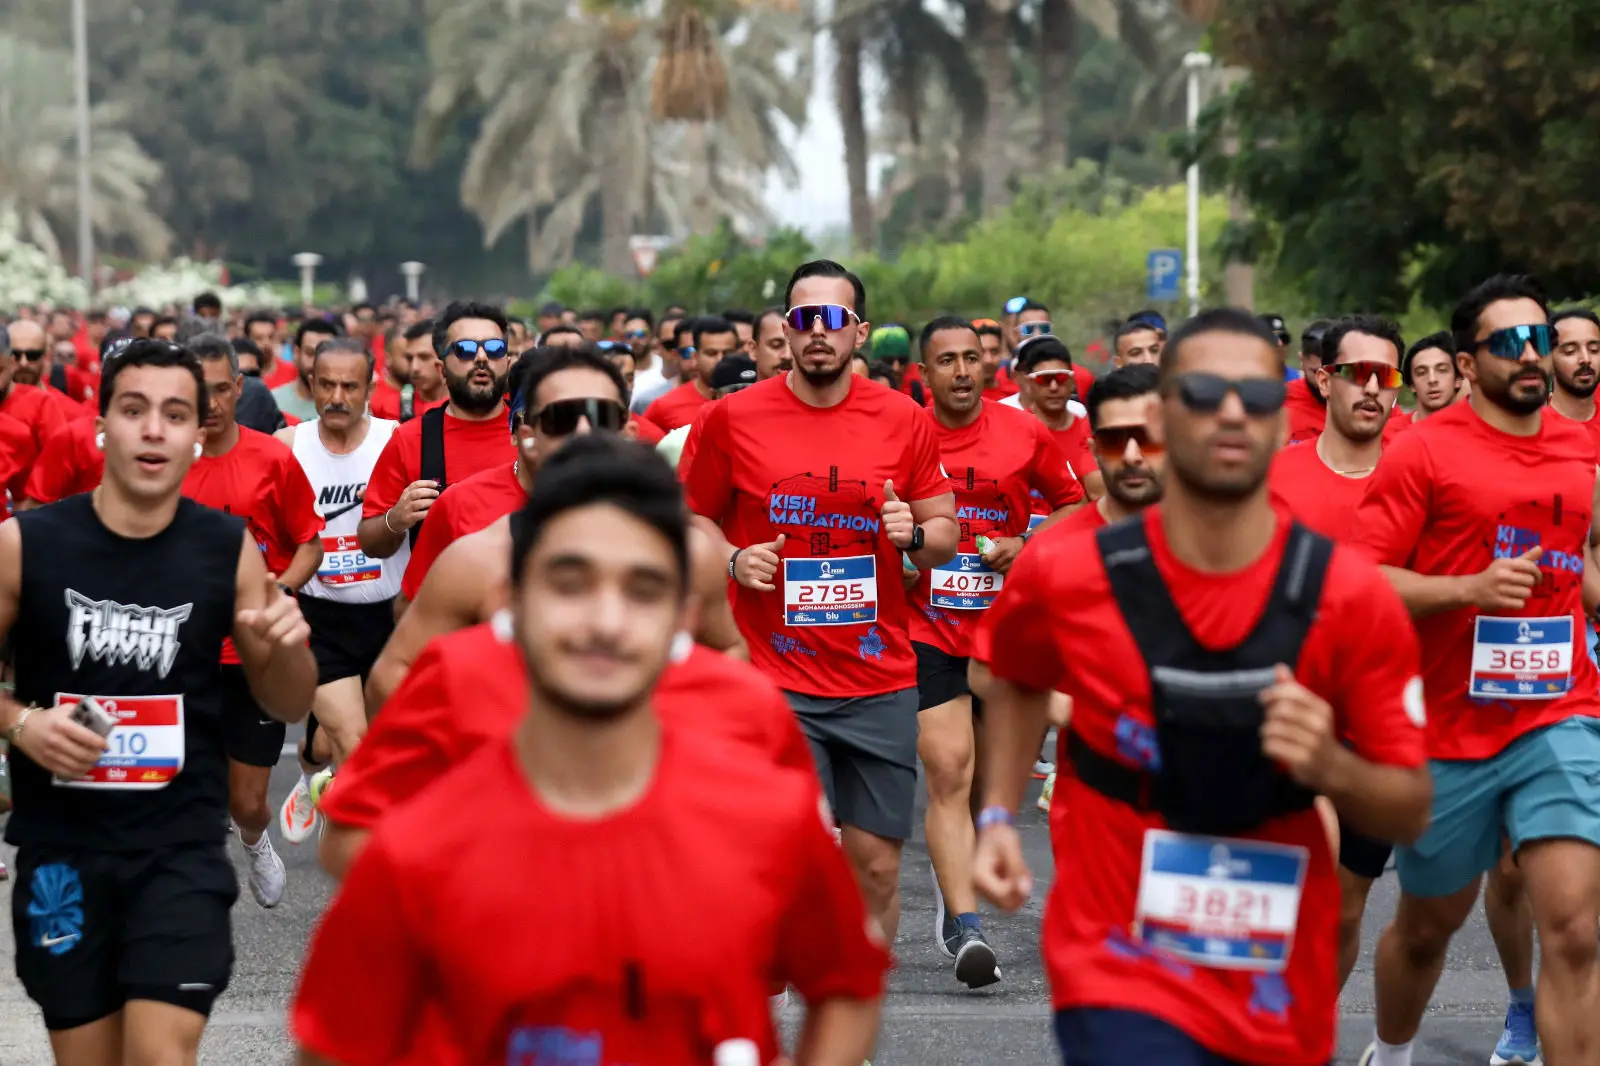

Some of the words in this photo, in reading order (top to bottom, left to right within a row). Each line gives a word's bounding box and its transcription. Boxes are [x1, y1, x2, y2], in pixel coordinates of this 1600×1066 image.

[1154, 255, 1175, 285] P
[770, 494, 816, 511] KISH
[770, 509, 879, 534] MARATHON
[957, 505, 1009, 522] ATHON
[329, 553, 366, 569] 558
[943, 574, 994, 590] 4079
[798, 583, 864, 602] 2795
[798, 602, 865, 611] MOHAMMADHOSSEIN
[825, 611, 839, 620] blu
[1489, 649, 1560, 670] 3658
[101, 732, 147, 755] 10
[1175, 884, 1271, 926] 3821
